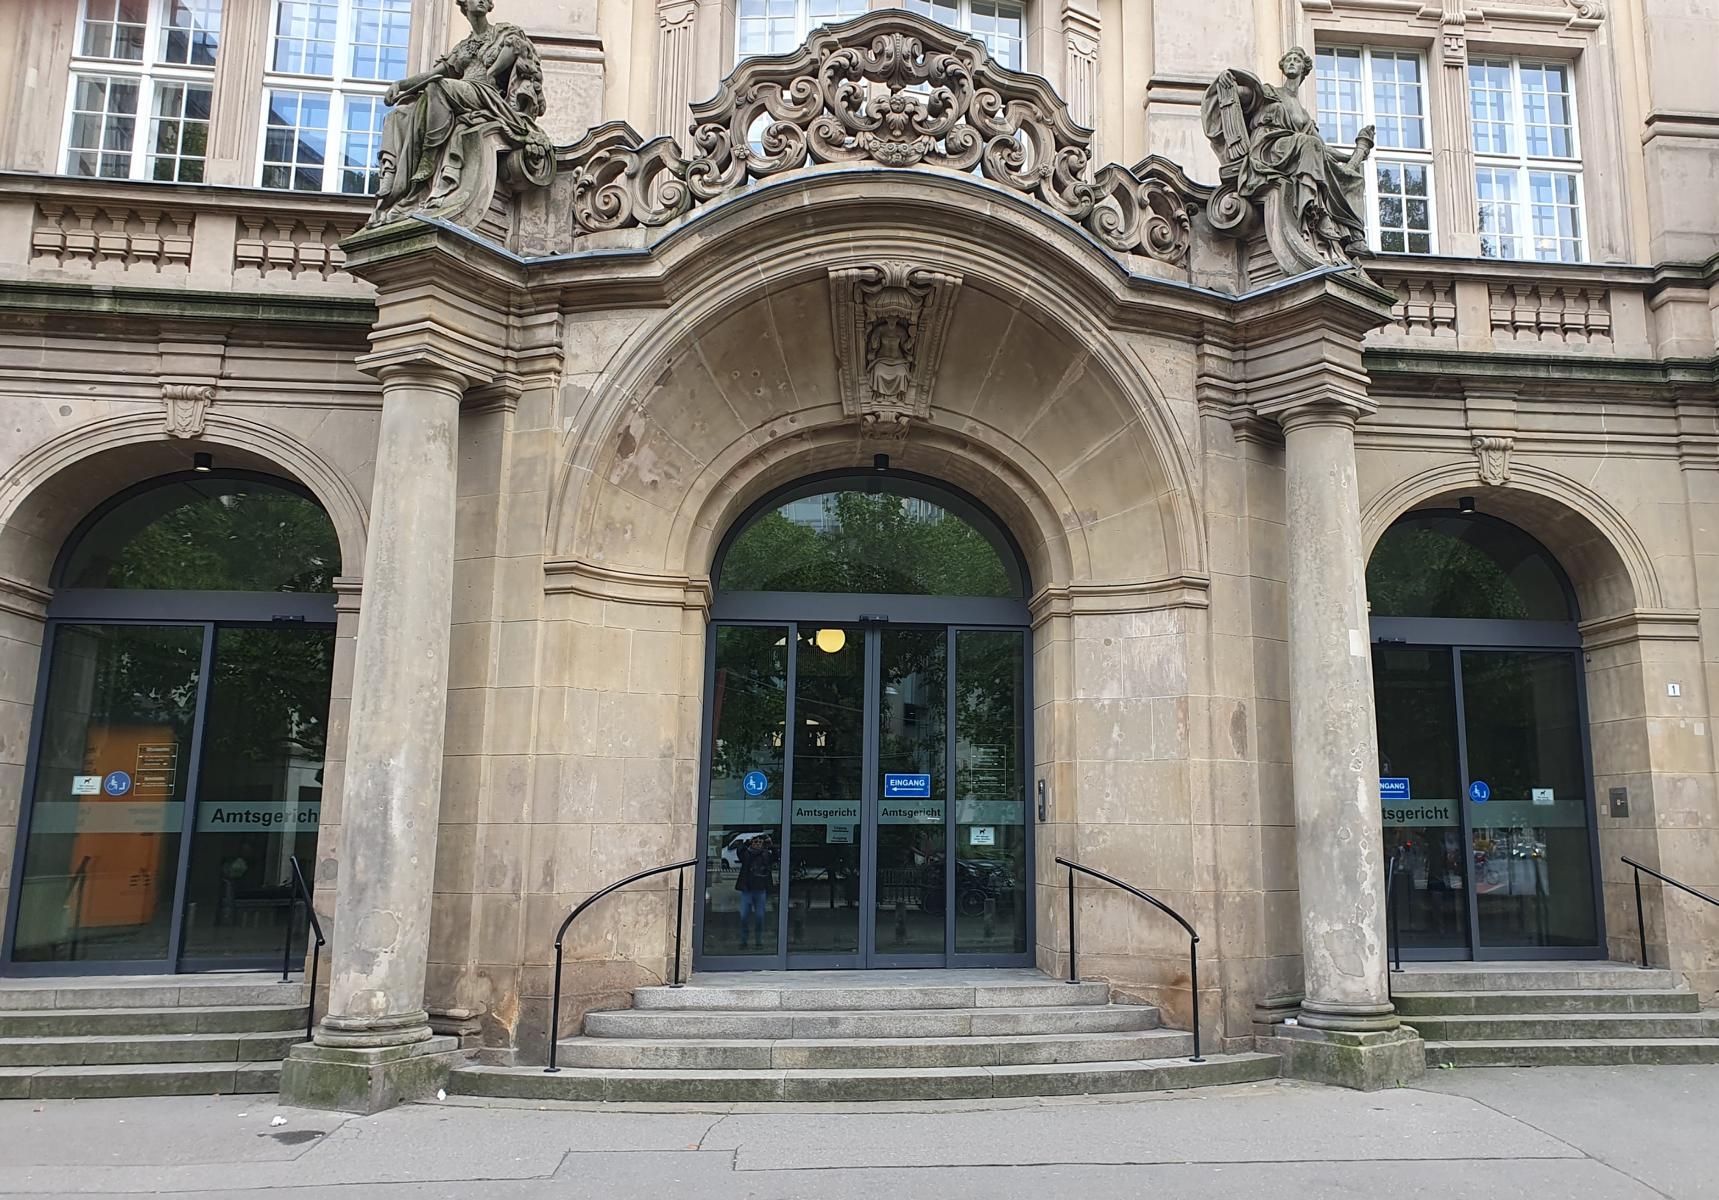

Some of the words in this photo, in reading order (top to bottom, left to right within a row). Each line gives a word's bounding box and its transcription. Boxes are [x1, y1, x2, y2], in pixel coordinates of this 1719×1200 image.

[890, 779, 925, 787] EINGANG
[1379, 782, 1405, 790] NGANG
[211, 808, 321, 827] Amtsgerich
[796, 807, 857, 819] Amtsgericht
[881, 807, 941, 819] Amtsgericht
[1382, 806, 1449, 823] tsgericht
